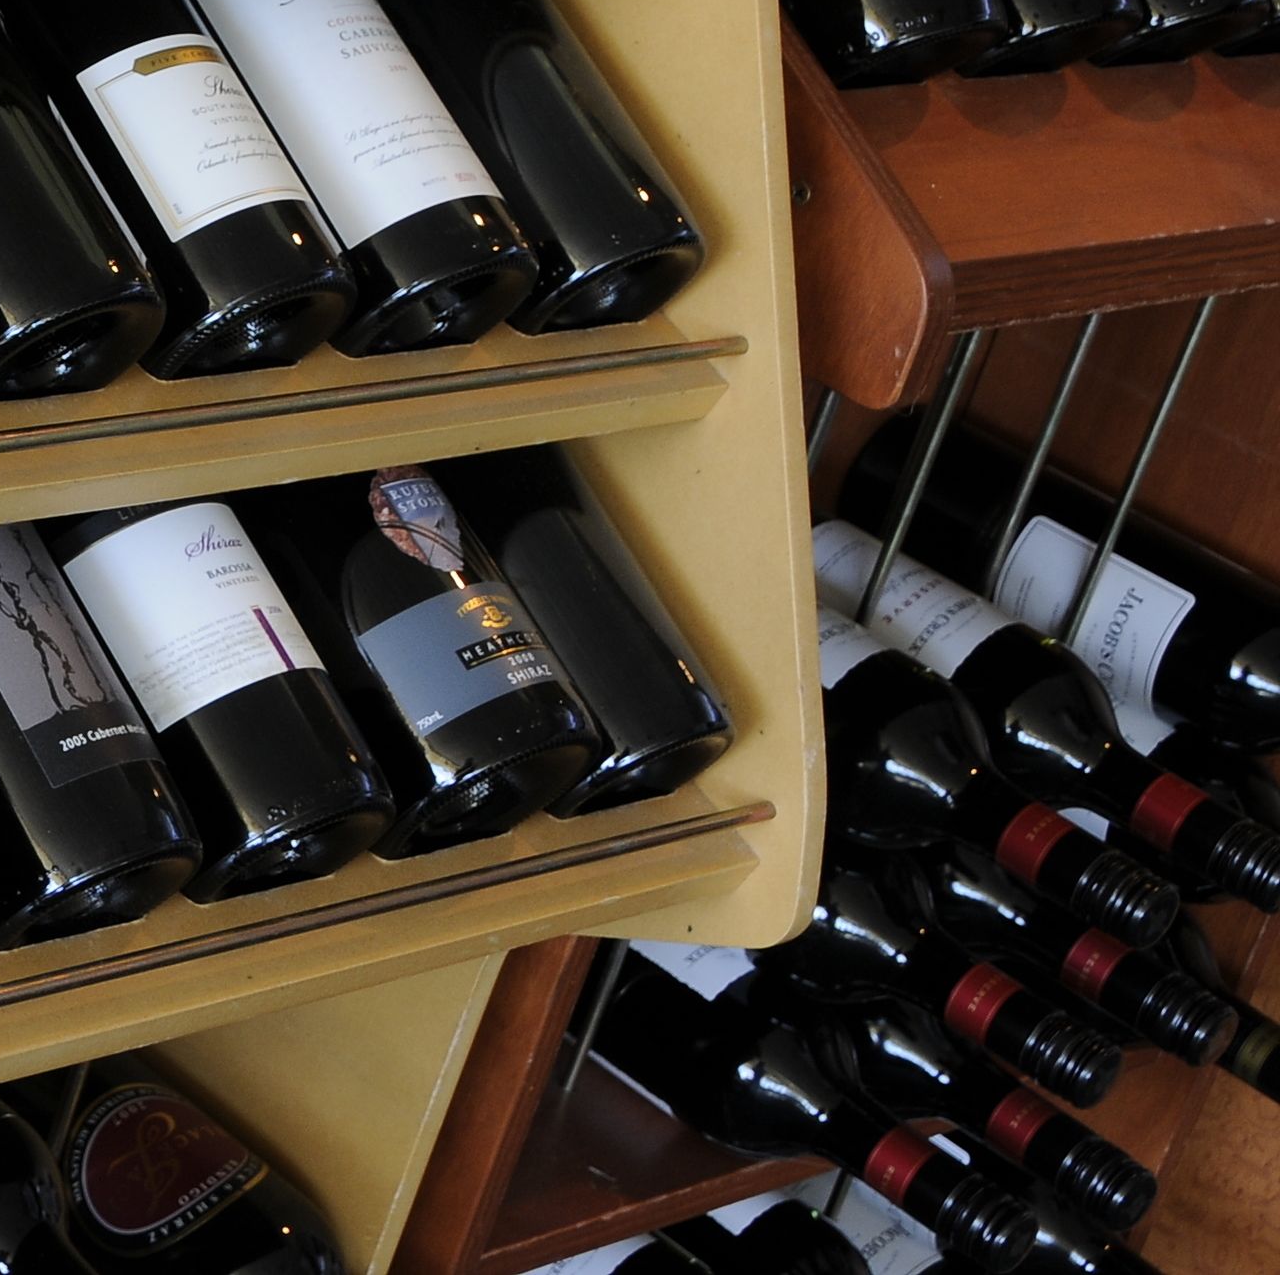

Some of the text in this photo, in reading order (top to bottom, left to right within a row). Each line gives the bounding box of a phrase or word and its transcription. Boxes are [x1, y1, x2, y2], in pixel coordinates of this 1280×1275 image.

[184, 525, 244, 563] Shiraz
[206, 561, 254, 580] BAROSSA
[508, 652, 535, 667] 2008
[507, 664, 552, 685] SHIRAZ
[416, 711, 444, 730] 750mL
[58, 722, 128, 754] 2005 Cabernet
